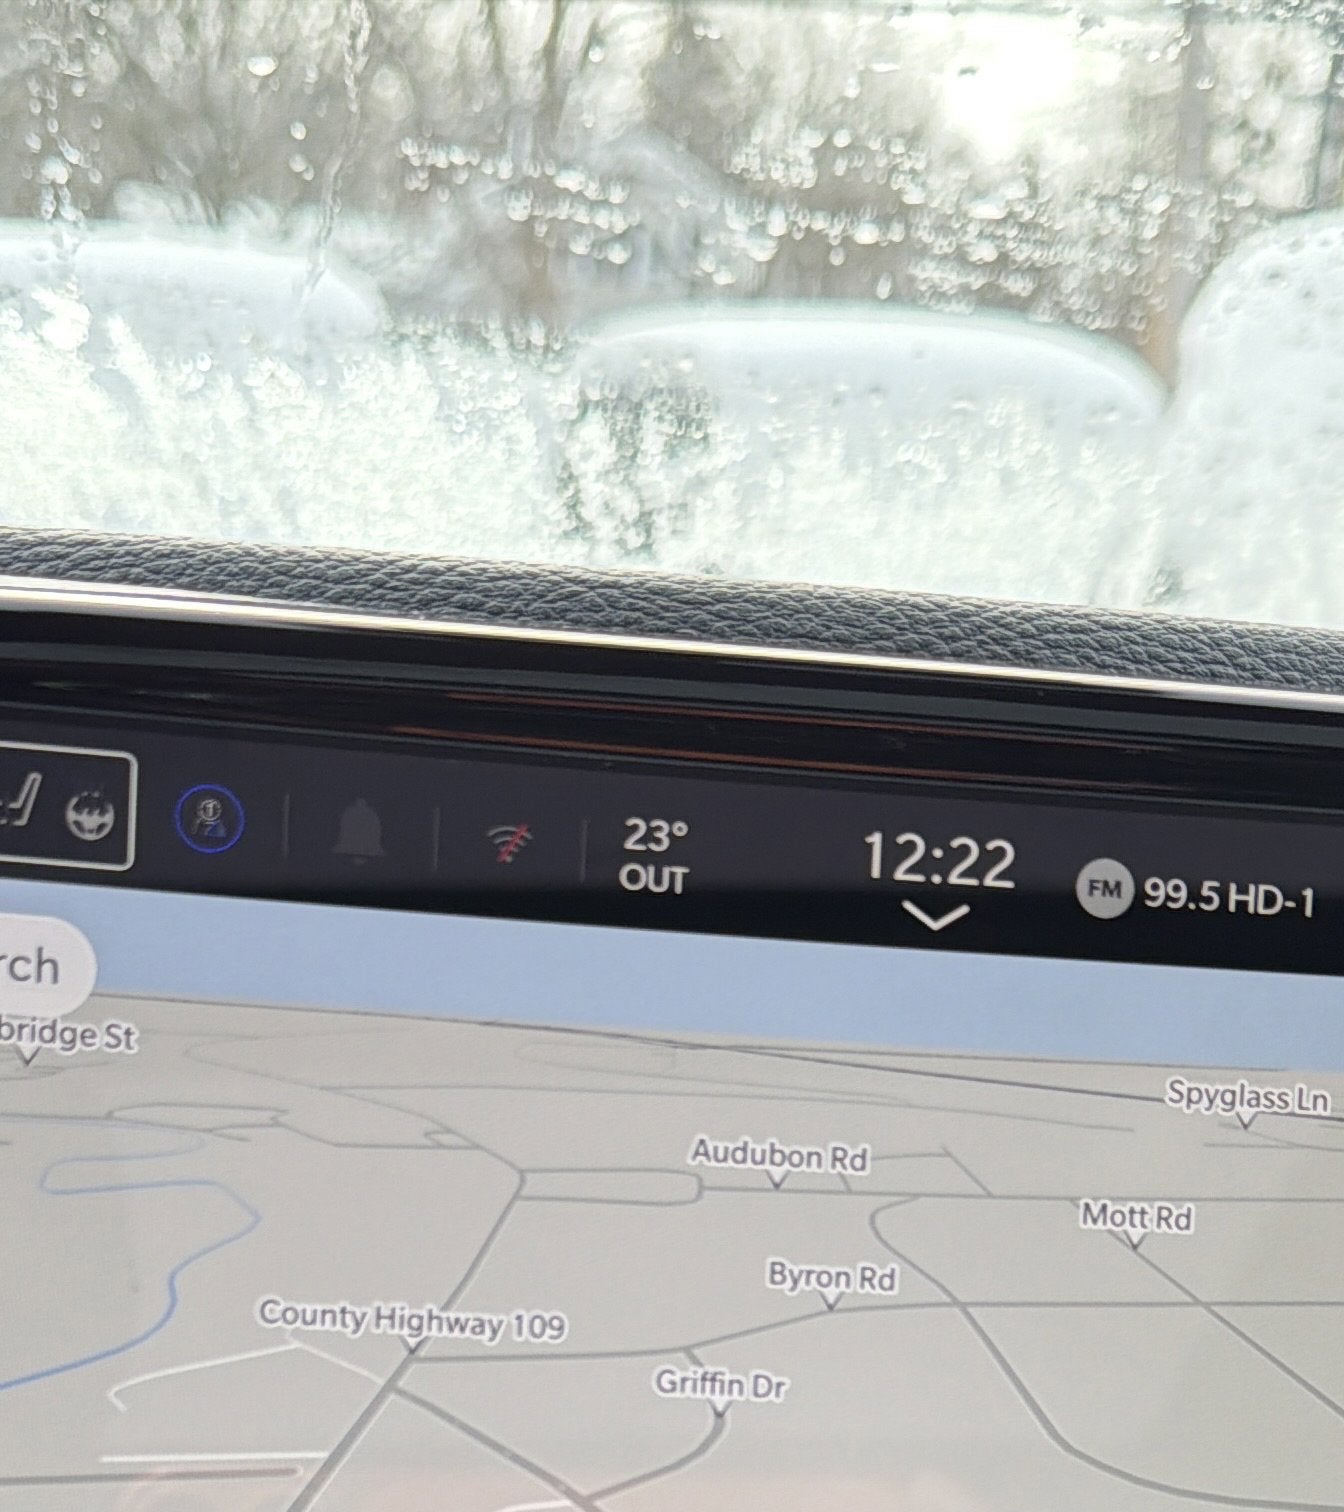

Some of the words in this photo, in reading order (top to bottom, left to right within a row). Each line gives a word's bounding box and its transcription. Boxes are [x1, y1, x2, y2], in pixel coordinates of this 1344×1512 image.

[865, 831, 1016, 889] 12:22
[619, 864, 689, 896] OUT
[1088, 879, 1123, 901] FM
[1143, 877, 1220, 913] 99.5
[1229, 882, 1315, 918] HD-1
[105, 1024, 136, 1051] St
[1167, 1080, 1290, 1111] Spyglass
[1297, 1087, 1329, 1112] Ln
[692, 1139, 823, 1170] Audubon
[832, 1146, 868, 1172] Rd
[1081, 1202, 1148, 1232] Mott
[1157, 1206, 1191, 1232] Rd
[769, 1262, 850, 1293] Byron
[859, 1266, 896, 1292] Rd
[259, 1301, 366, 1334] County
[375, 1307, 505, 1342] Highway
[515, 1315, 566, 1341] 109
[656, 1370, 744, 1399] Griffin
[753, 1373, 786, 1399] Dr
